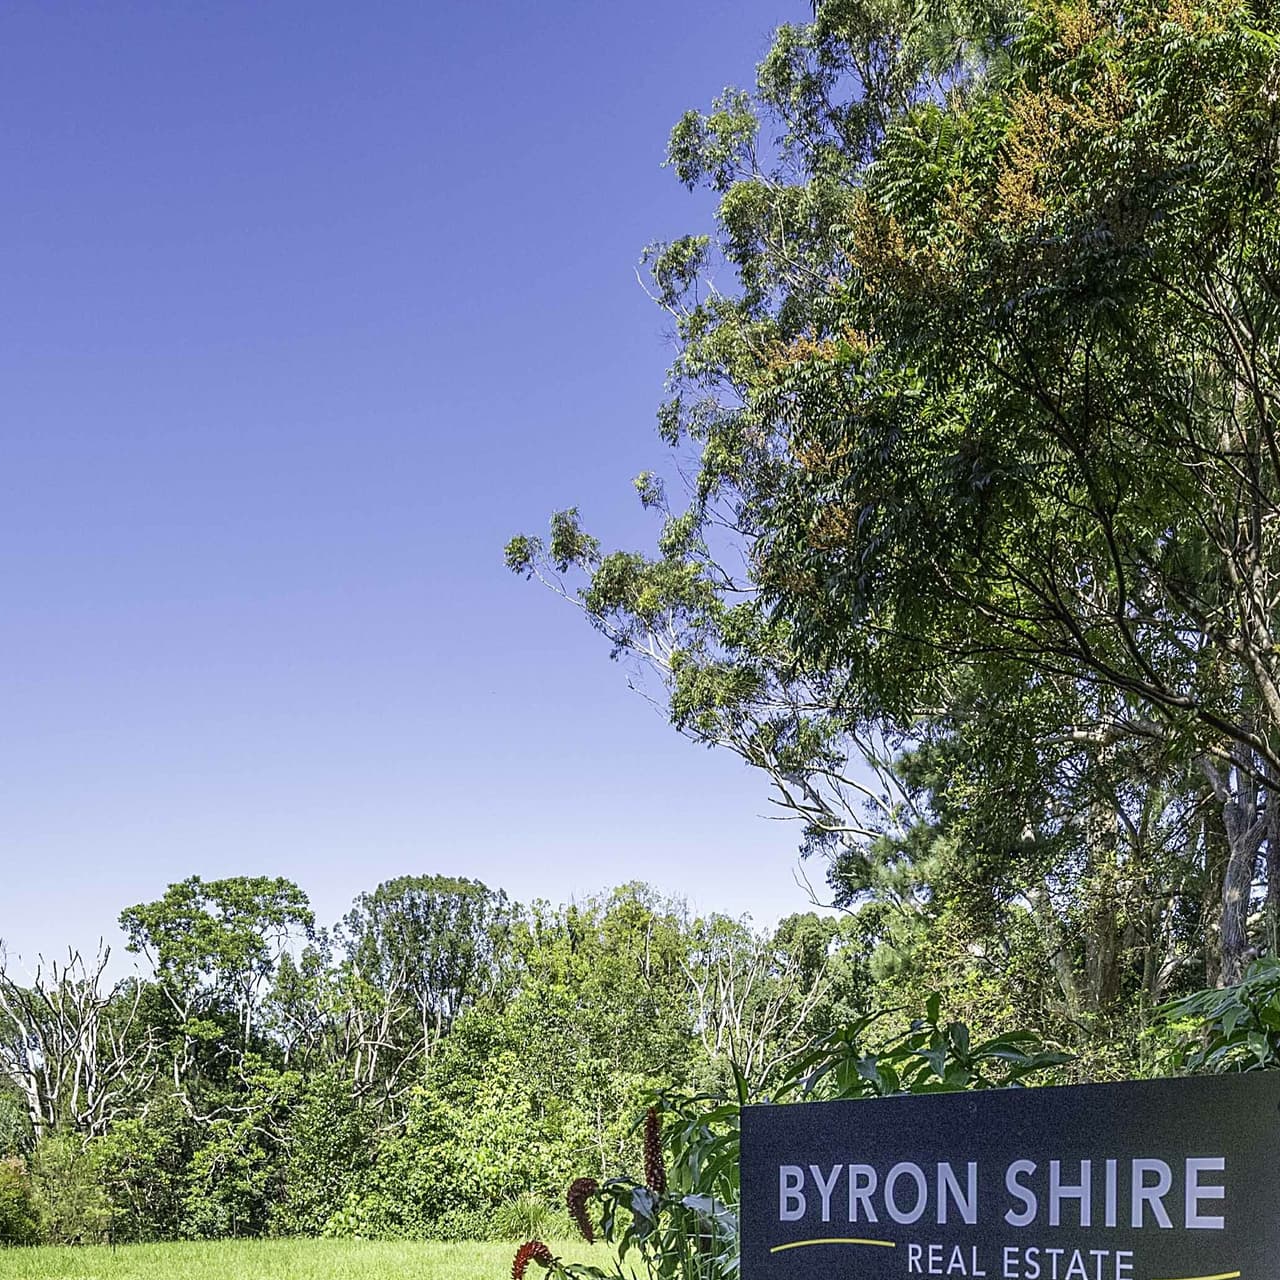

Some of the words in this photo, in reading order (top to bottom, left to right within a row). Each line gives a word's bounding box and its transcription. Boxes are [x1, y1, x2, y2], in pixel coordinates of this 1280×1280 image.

[780, 1162, 978, 1224] BYRON
[1004, 1157, 1225, 1230] SHIRE
[908, 1244, 987, 1277] REAL
